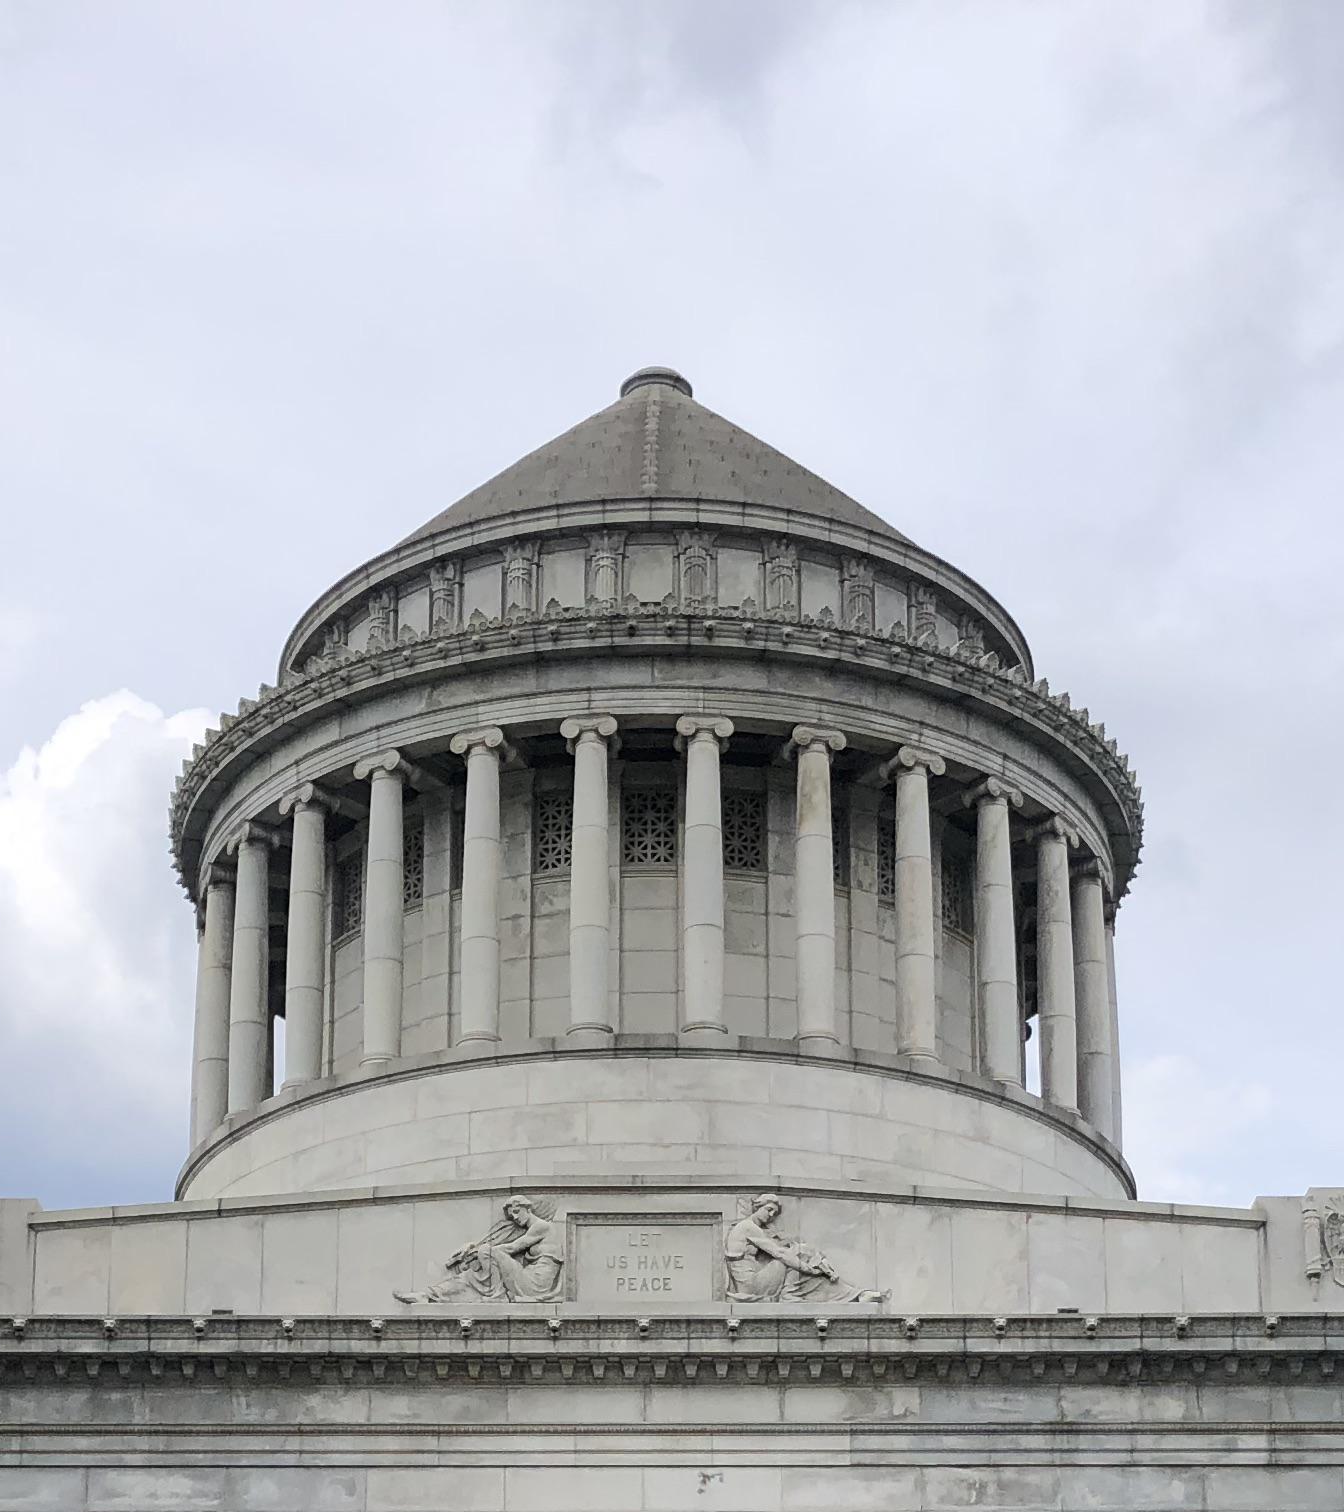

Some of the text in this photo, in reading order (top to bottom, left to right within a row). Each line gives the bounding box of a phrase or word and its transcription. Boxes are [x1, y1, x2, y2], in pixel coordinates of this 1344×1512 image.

[628, 1232, 662, 1247] LET
[606, 1255, 684, 1270] US HAVE
[616, 1277, 672, 1292] PEACE
